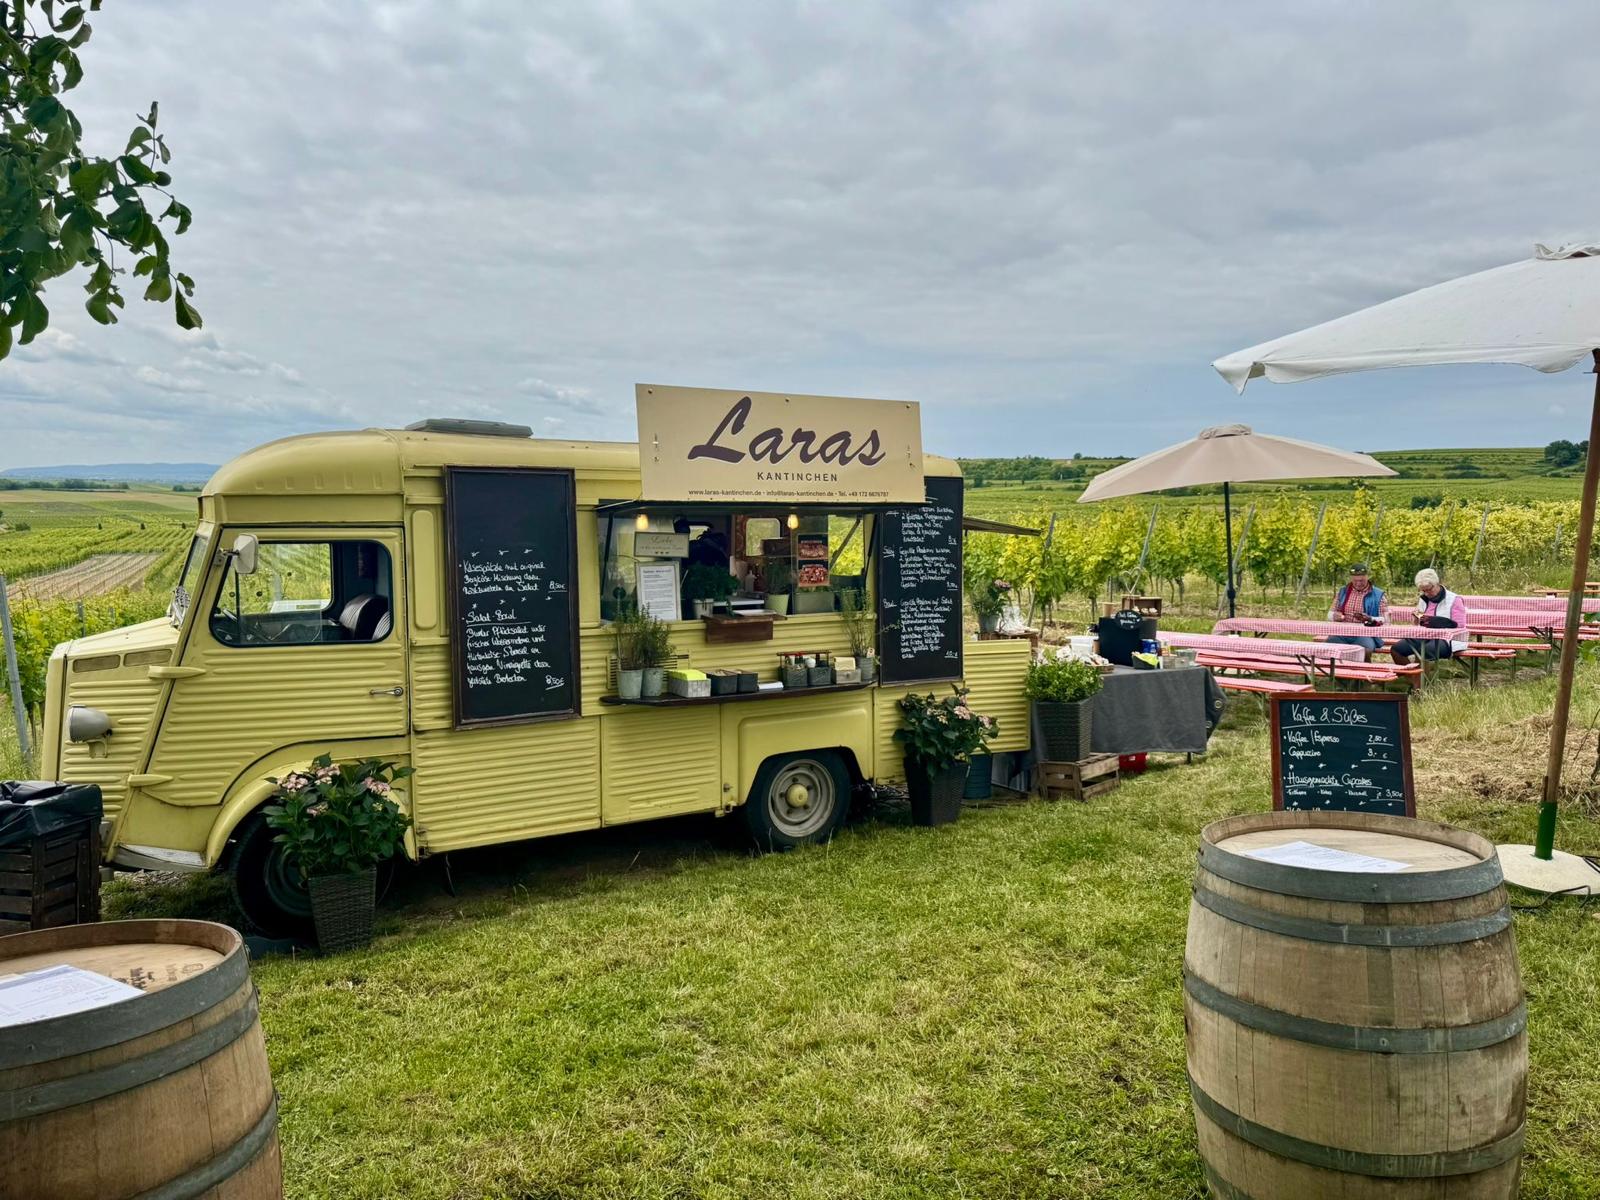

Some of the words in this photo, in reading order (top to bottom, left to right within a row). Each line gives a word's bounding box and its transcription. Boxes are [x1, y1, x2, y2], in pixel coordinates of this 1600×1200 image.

[687, 396, 886, 466] Laras
[757, 472, 838, 482] KANTINCHEN
[688, 488, 761, 496] www.laras-kantinchen.de
[531, 634, 546, 642] und
[1291, 703, 1317, 725] Kaffee
[1320, 707, 1331, 724] &
[1332, 707, 1368, 726] Süßes
[1287, 730, 1309, 747] Kaffee
[1341, 773, 1373, 788] Cupcakes
